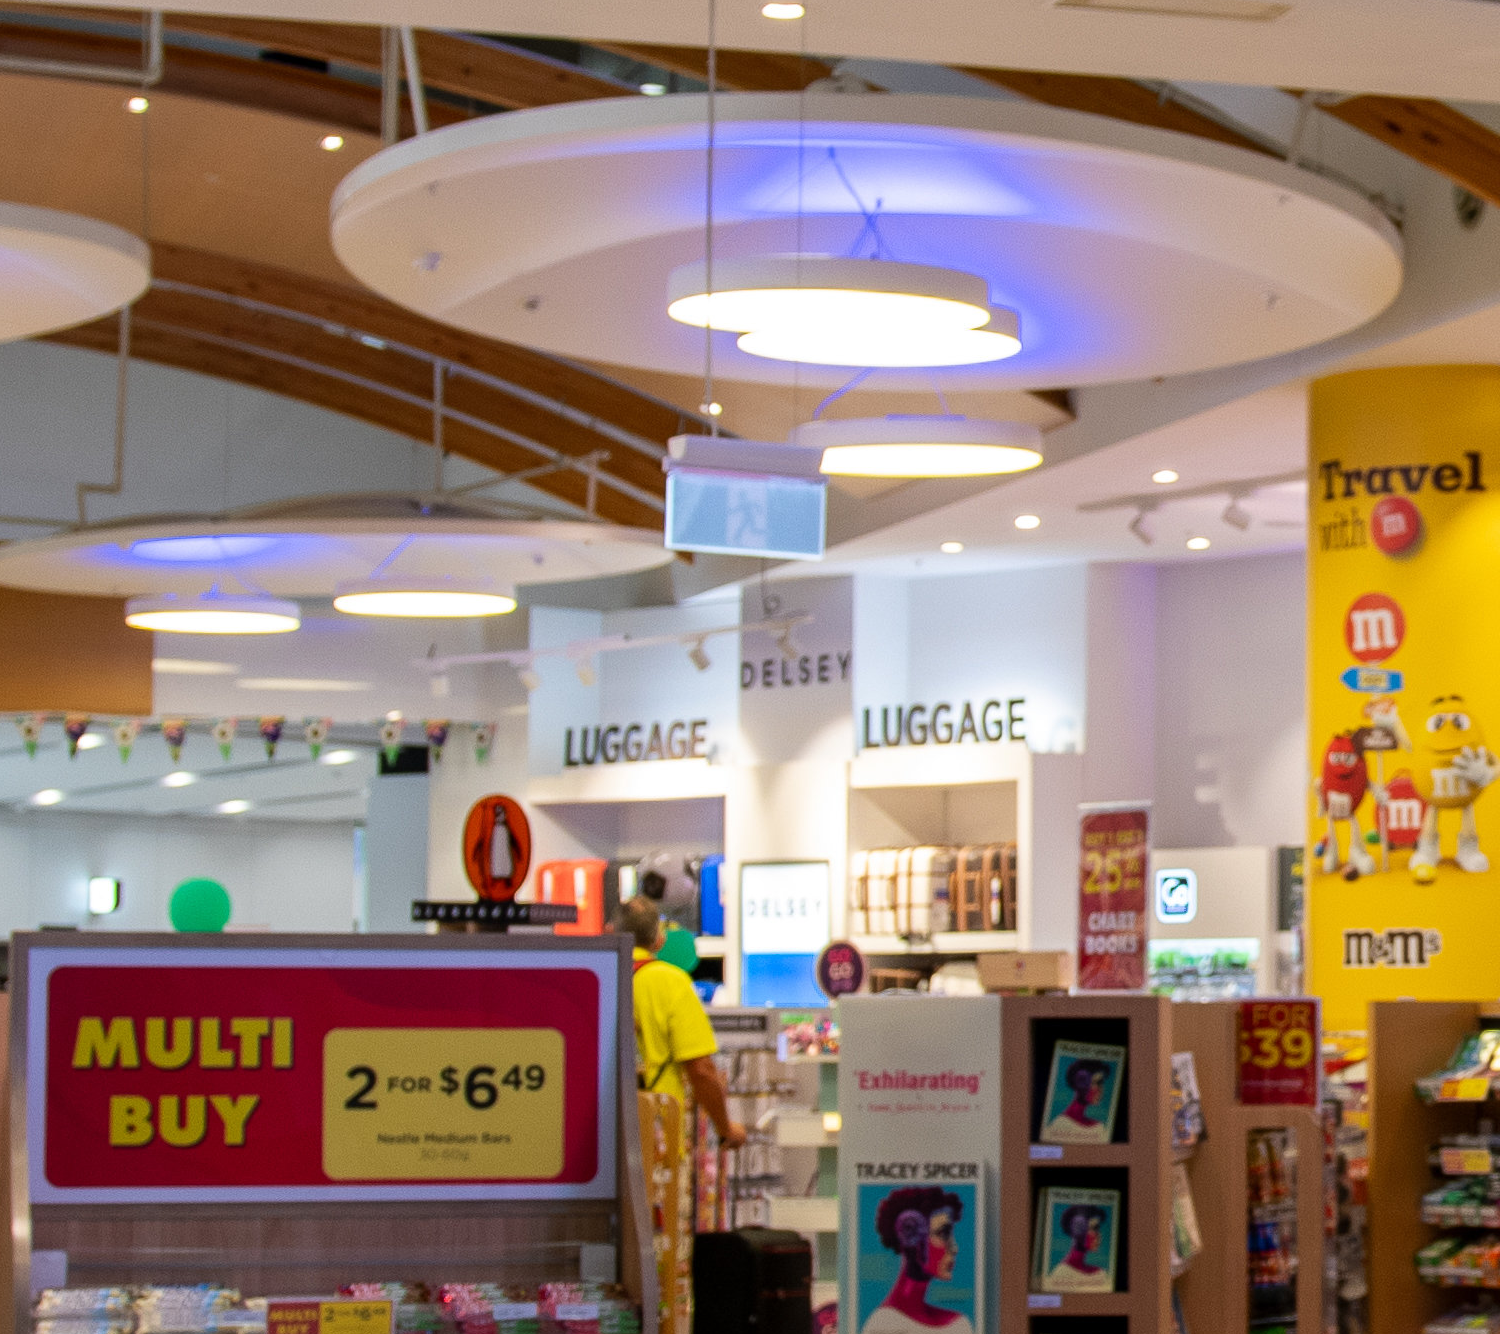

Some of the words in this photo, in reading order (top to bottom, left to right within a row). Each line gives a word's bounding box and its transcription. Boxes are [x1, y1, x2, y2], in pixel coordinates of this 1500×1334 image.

[1319, 451, 1486, 501] Travel
[741, 651, 852, 689] DELSEY
[564, 719, 708, 767] LUGGAGE
[863, 698, 1027, 749] LUGGAGE
[1088, 910, 1137, 931] CHART
[1252, 1004, 1310, 1028] FOR
[71, 1016, 296, 1069] MULTI
[344, 1065, 378, 1111] 2
[386, 1075, 432, 1094] FOR
[109, 1094, 261, 1148] BUY
[423, 1131, 478, 1146] Medium
[481, 1131, 512, 1146] Bars
[857, 1161, 919, 1179] TRACEY
[923, 1161, 979, 1180] SPICER
